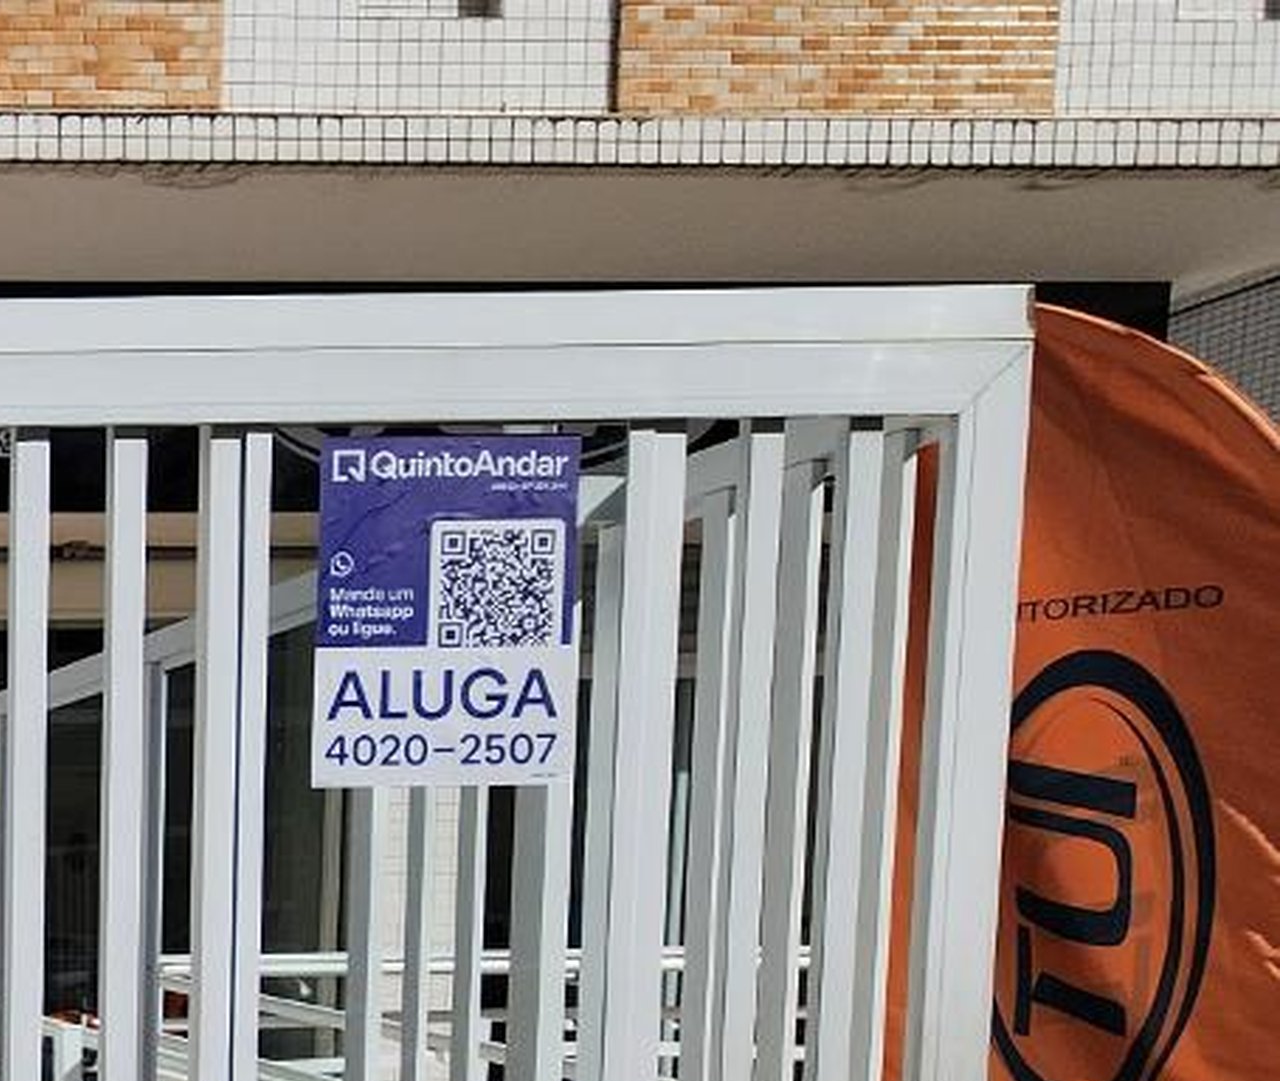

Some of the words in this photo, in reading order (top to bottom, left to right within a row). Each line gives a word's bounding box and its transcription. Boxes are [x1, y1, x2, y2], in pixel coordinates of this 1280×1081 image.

[370, 450, 569, 479] QuintoAndar
[329, 587, 385, 601] Mande
[387, 588, 414, 601] um
[328, 623, 349, 637] ou
[326, 668, 557, 721] ALUGA
[325, 733, 557, 766] 4020-2507
[1004, 760, 1137, 1037] TUI
